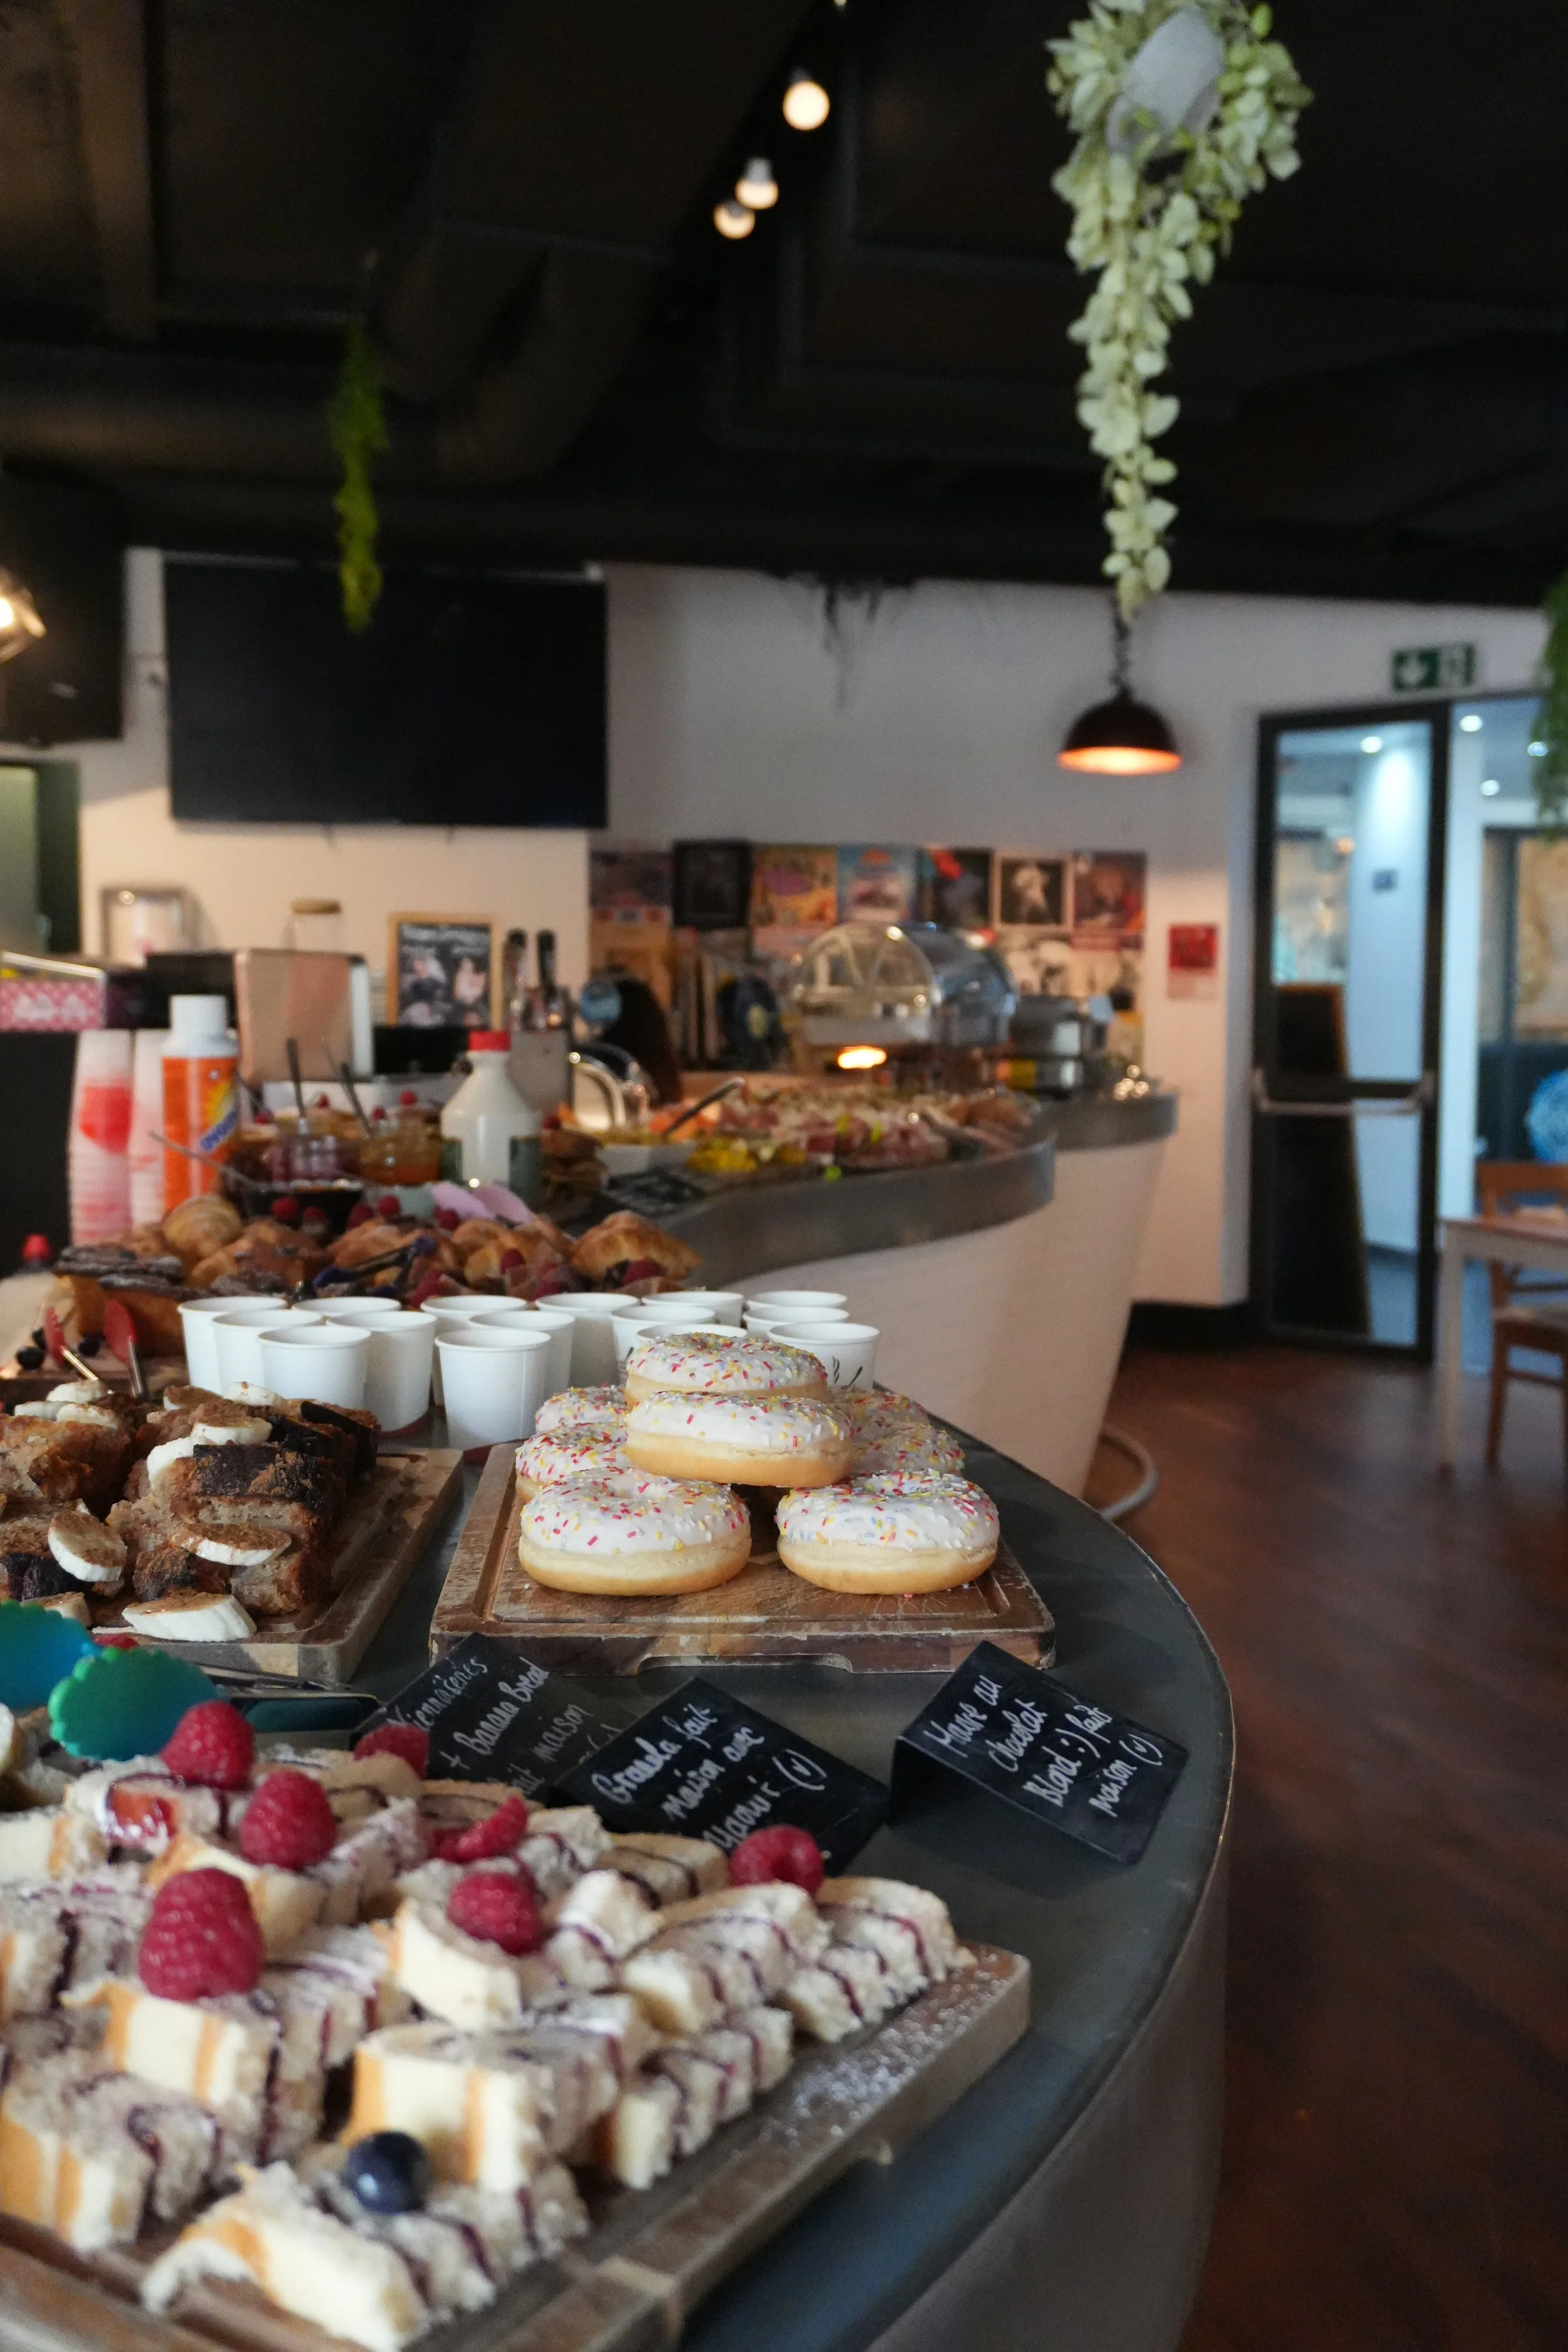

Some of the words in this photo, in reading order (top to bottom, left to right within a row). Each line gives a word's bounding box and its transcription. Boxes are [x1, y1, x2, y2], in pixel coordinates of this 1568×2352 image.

[453, 1700, 519, 1756] Banana
[498, 1656, 549, 1702] Bread
[973, 1675, 1002, 1706] au
[662, 1703, 718, 1749] fait
[723, 1726, 765, 1762] avec
